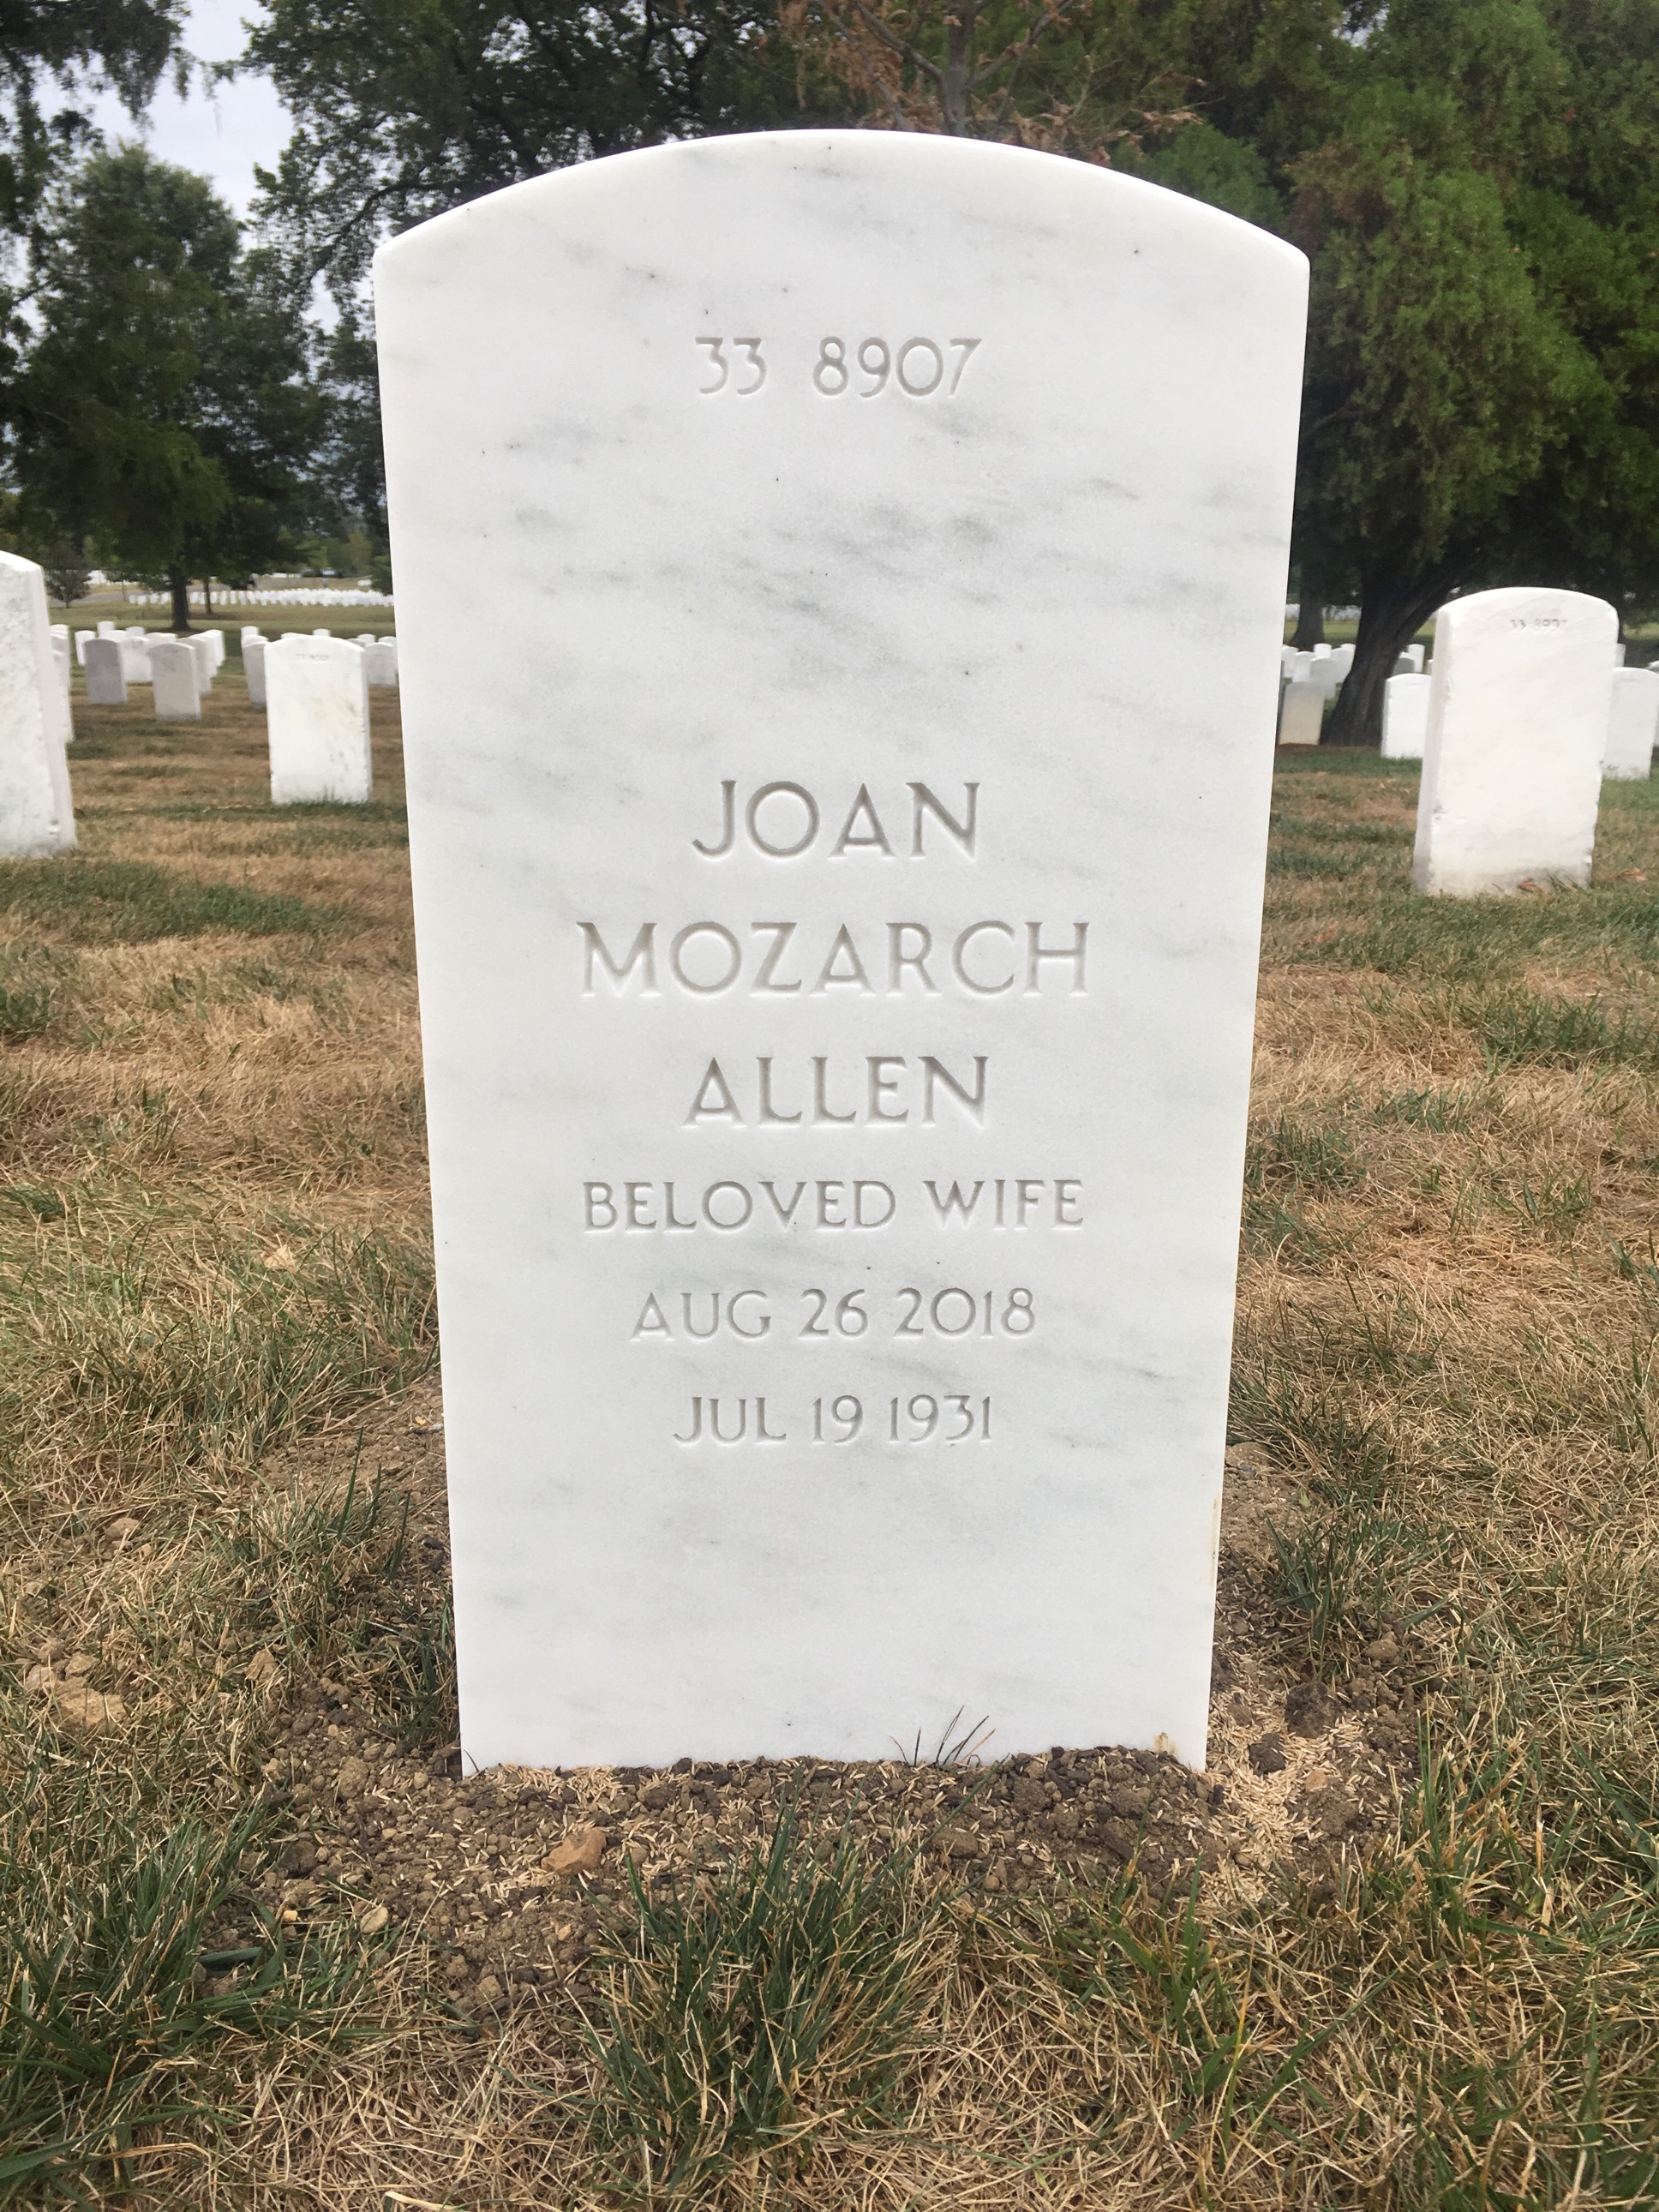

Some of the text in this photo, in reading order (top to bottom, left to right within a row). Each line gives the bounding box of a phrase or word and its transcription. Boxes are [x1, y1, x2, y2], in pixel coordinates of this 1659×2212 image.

[695, 335, 983, 398] 33 8907
[692, 779, 979, 860] JOAN
[576, 920, 1090, 998] MOZARCH
[682, 1055, 989, 1129] ALLEN
[583, 1178, 1084, 1234] BELOVED WIFE
[630, 1286, 1037, 1340] AUG 26 2018
[673, 1394, 992, 1445] JUL 19 1931
